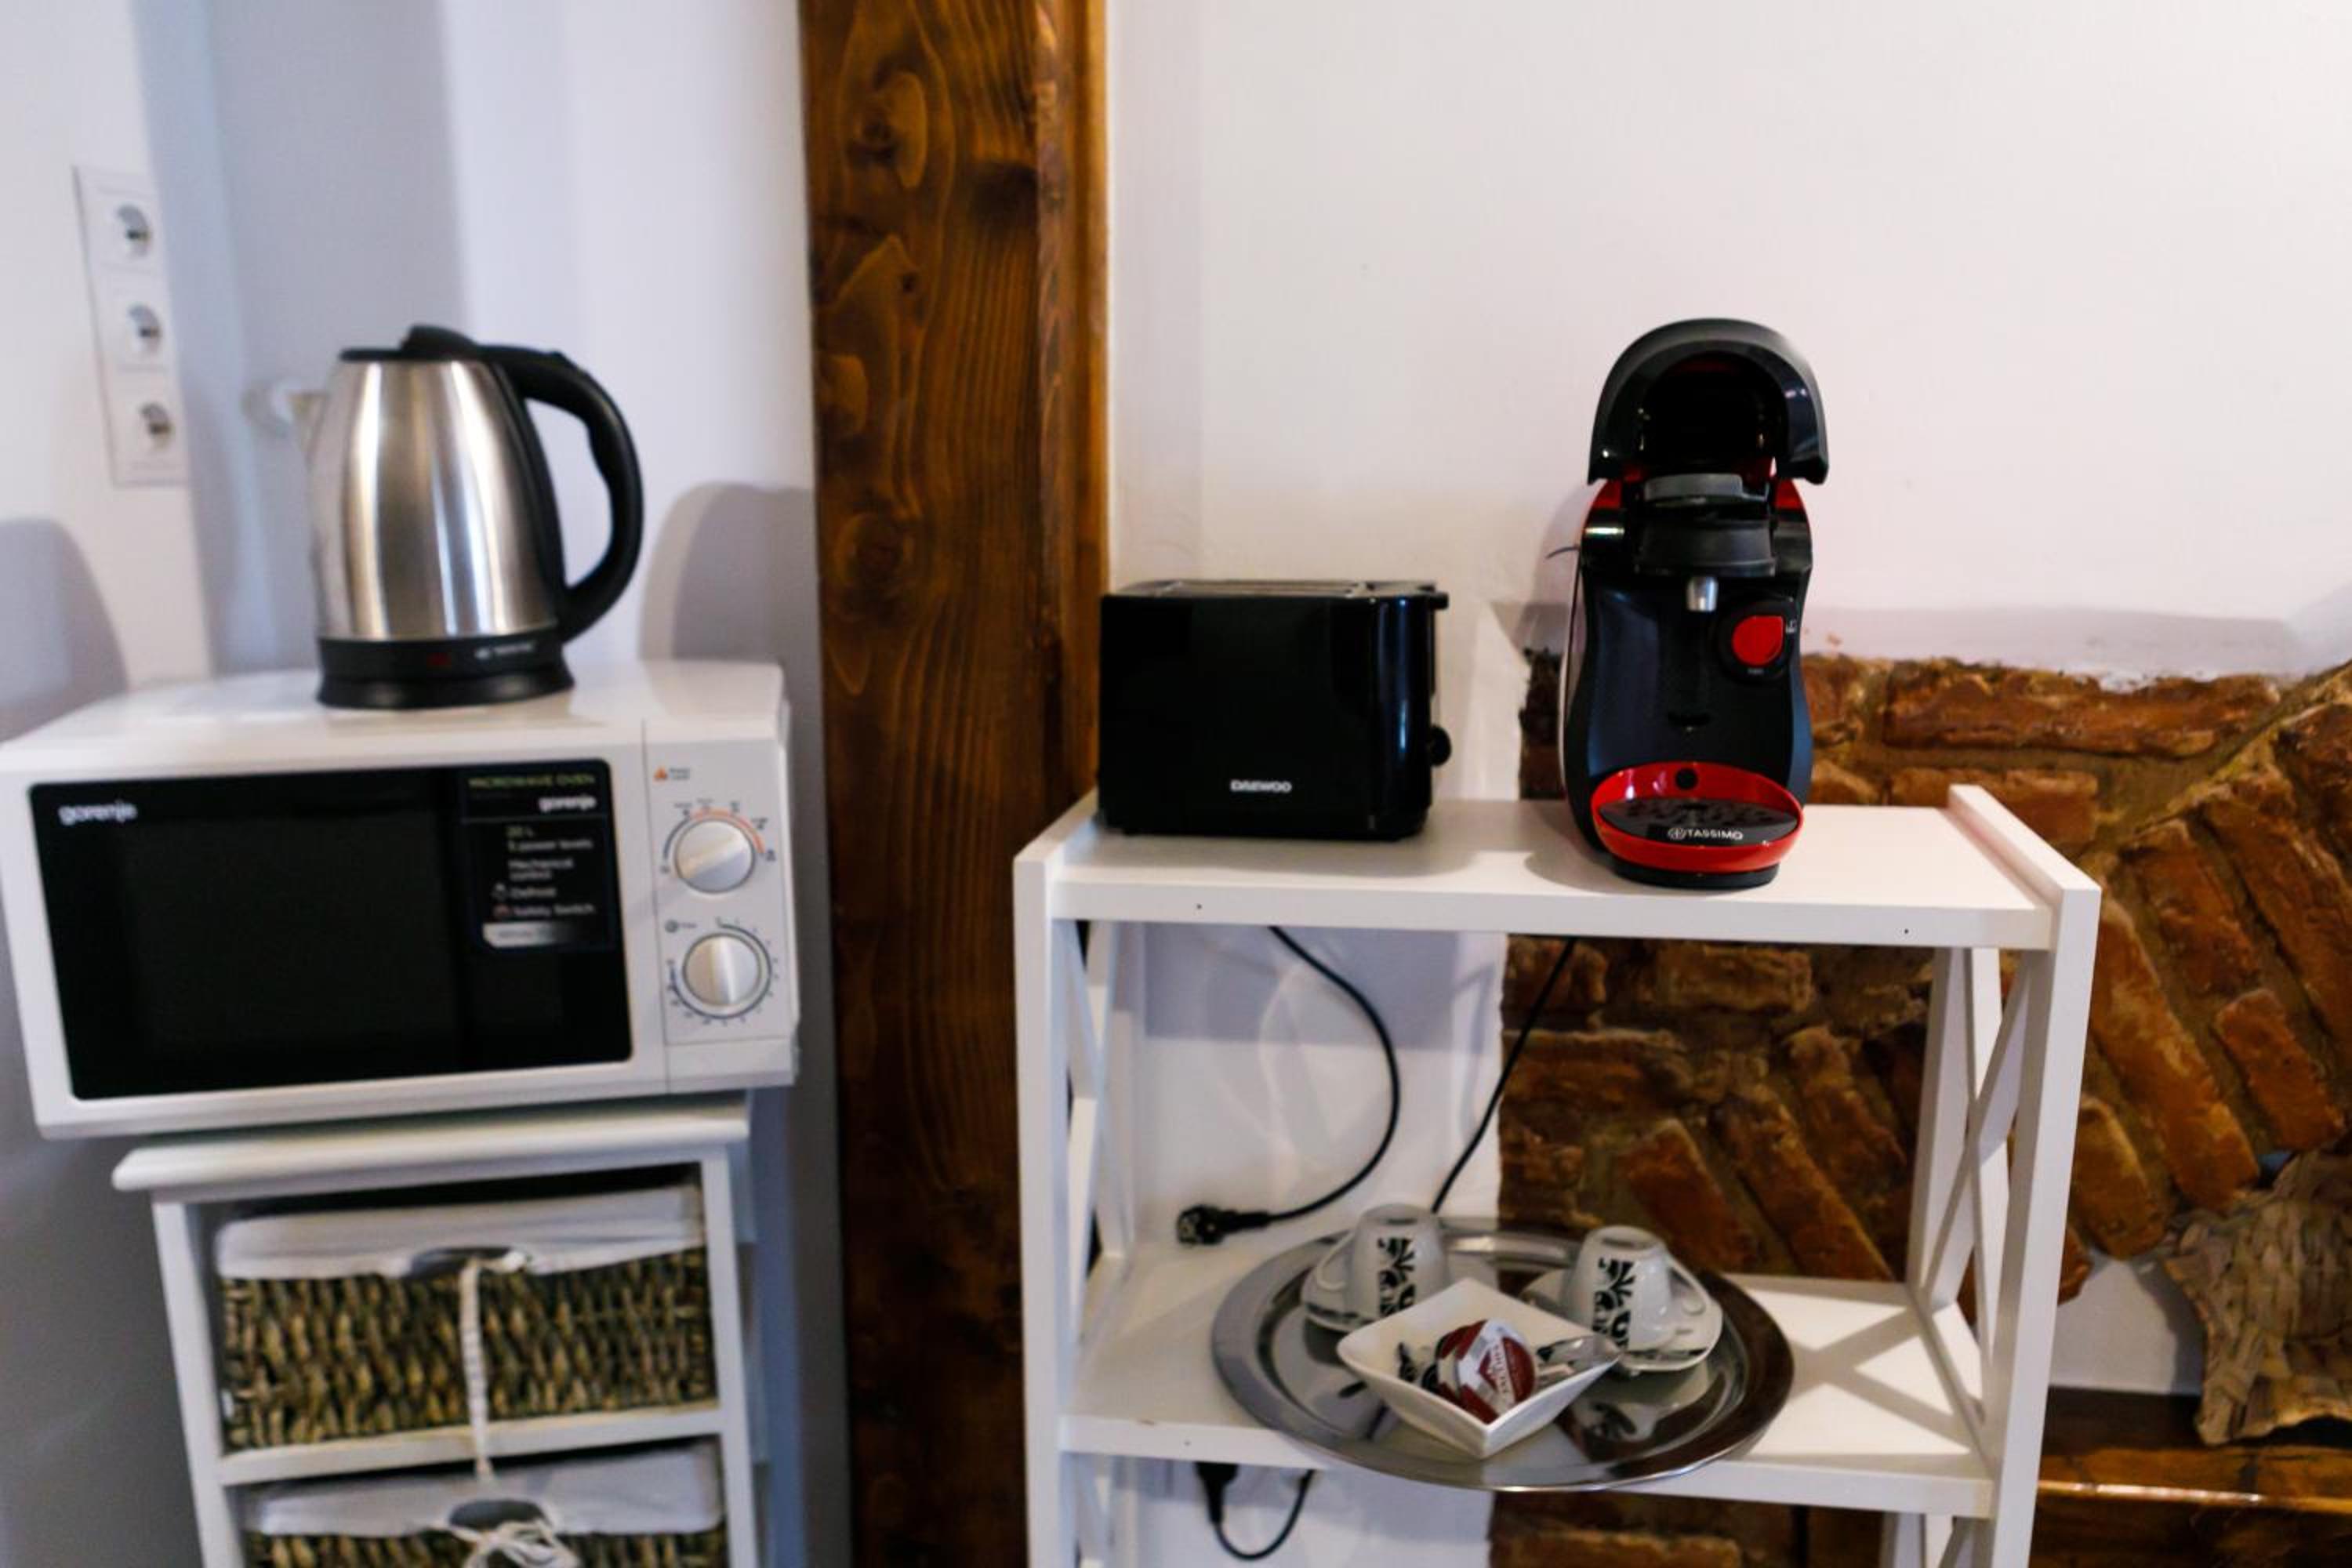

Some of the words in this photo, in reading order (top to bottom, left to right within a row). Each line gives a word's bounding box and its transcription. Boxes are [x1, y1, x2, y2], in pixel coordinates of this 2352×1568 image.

[1230, 779, 1293, 793] DAEWOO
[539, 793, 597, 813] gorenje
[1686, 829, 1744, 840] TASSIMO
